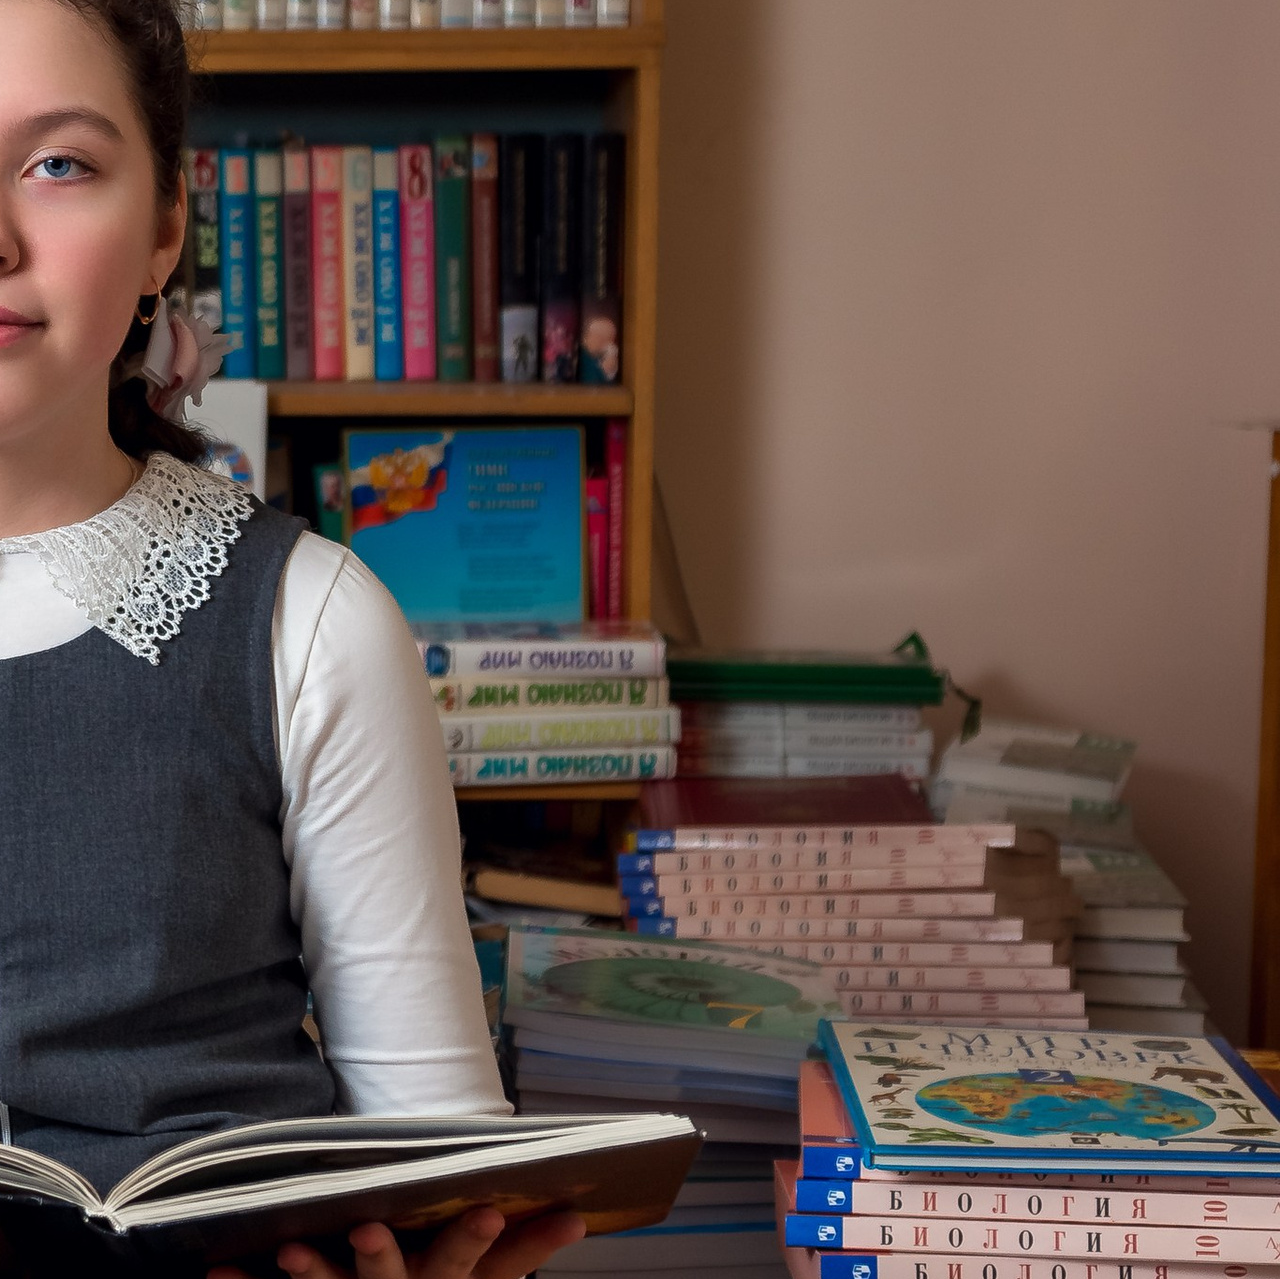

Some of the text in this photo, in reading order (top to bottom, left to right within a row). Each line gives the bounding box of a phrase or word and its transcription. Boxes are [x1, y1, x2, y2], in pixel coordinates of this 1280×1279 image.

[408, 152, 427, 199] 8
[479, 650, 633, 670] Я ПОЗНАЮ МИР
[468, 680, 646, 707] Я ПОЗНАЮ МИР
[477, 754, 657, 778] Я ПОЗНАЮ МИР
[679, 850, 852, 871] БИОЛОГИЯ
[682, 873, 852, 894] БИОЛОГИЯ
[688, 897, 860, 916] БИОЛОГИЯ
[703, 921, 883, 937] БИОЛОГИЯ
[706, 1002, 765, 1028] 7
[947, 1032, 1108, 1051] МИР
[864, 1041, 897, 1053] И
[920, 1041, 1203, 1066] ЧЕЛОВЕК
[1030, 1070, 1066, 1083] 2
[890, 1189, 1229, 1223] БИОЛОГИЯ 10
[881, 1225, 1220, 1258] БИОЛОГИЯ 10
